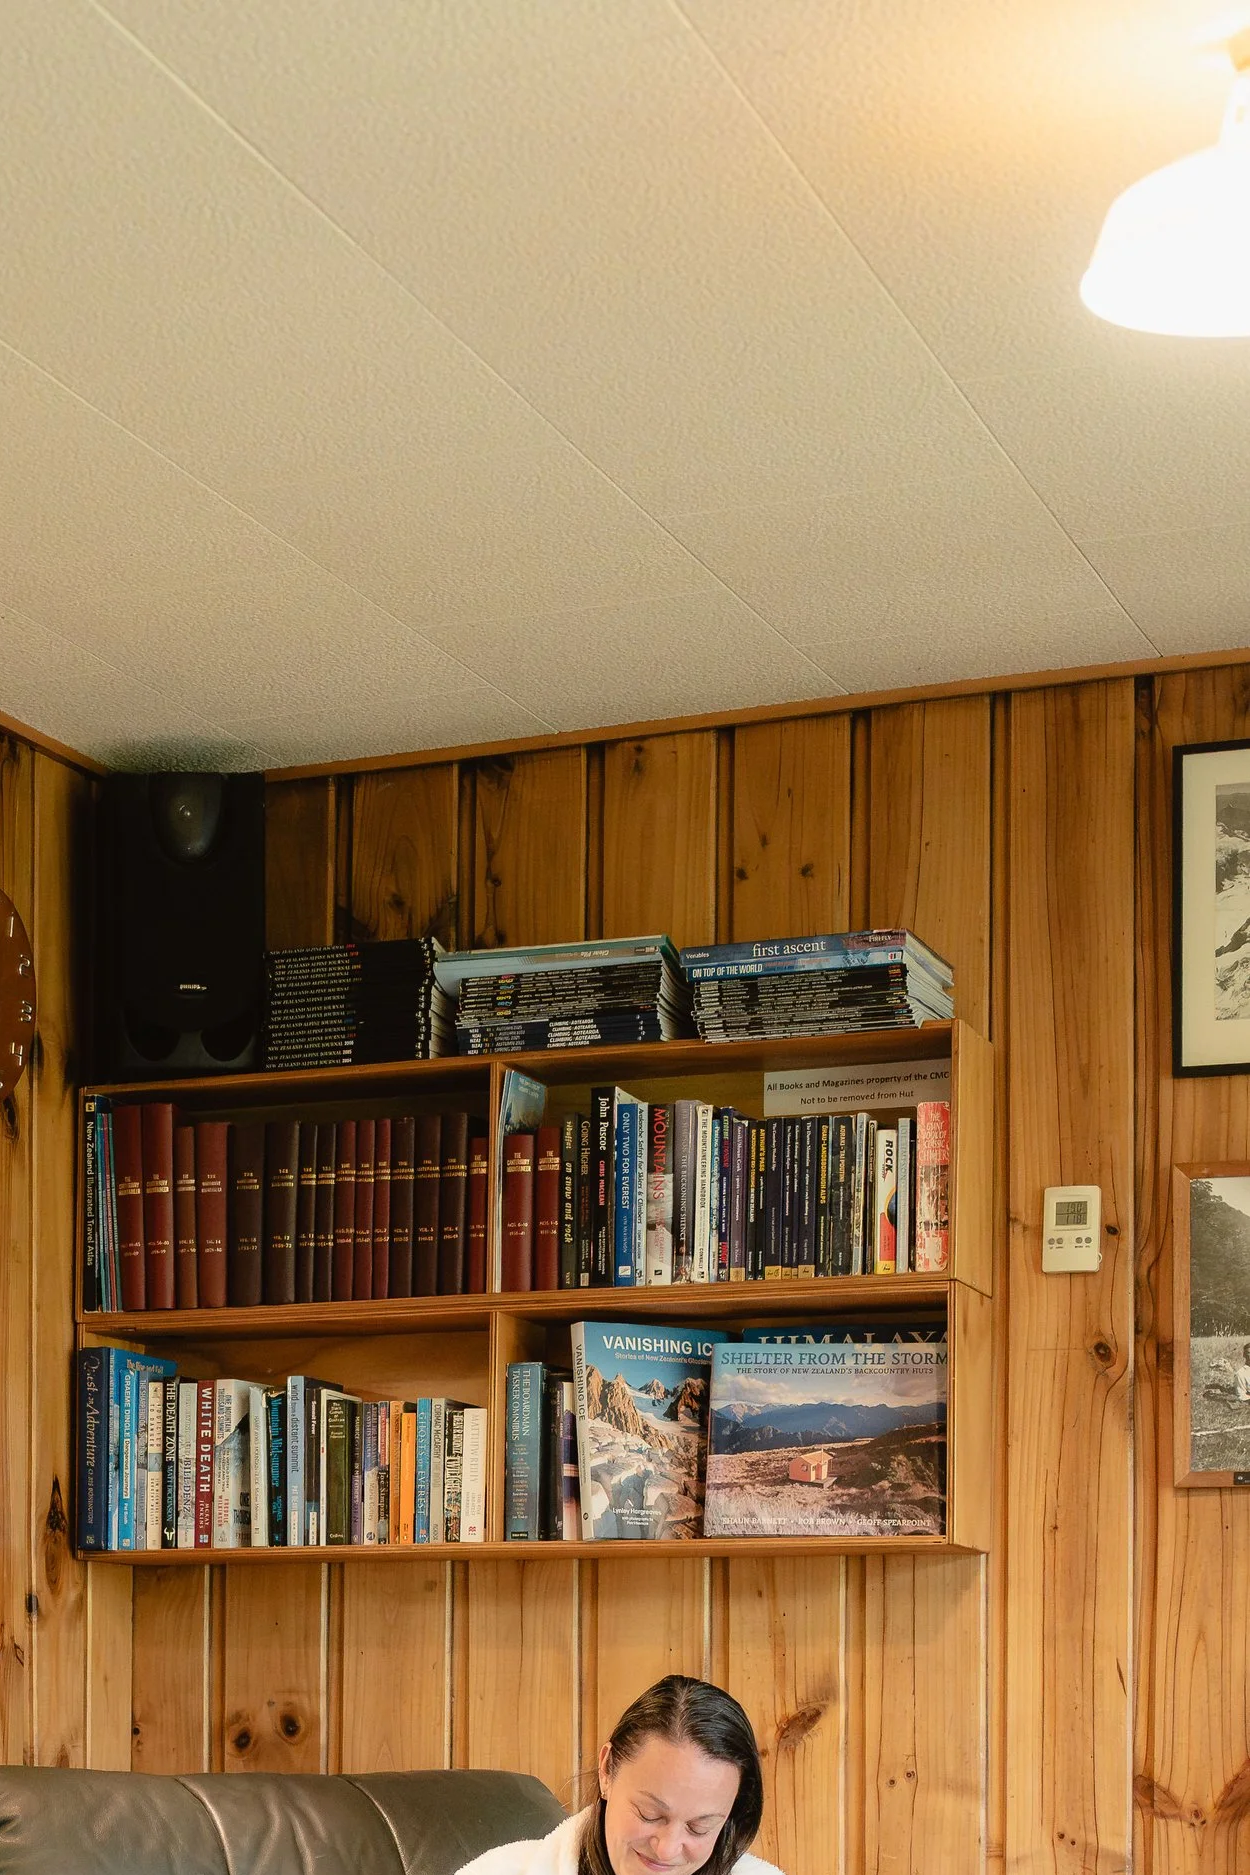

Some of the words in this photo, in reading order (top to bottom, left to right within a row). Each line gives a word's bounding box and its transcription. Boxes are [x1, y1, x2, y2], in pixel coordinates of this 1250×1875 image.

[9, 911, 15, 938] 1
[686, 951, 710, 960] Venables
[752, 942, 780, 957] first
[783, 940, 826, 954] ascent
[18, 954, 30, 977] 2
[692, 968, 702, 978] ON
[703, 967, 716, 977] TOP
[716, 966, 726, 976] OF
[726, 966, 738, 975] THE
[738, 964, 762, 974] WORLD
[20, 1000, 32, 1022] 3
[11, 1042, 23, 1067] 4
[766, 1084, 778, 1092] All
[780, 1082, 804, 1090] Books
[822, 1078, 864, 1088] Magazines
[866, 1075, 902, 1086] property
[903, 1074, 913, 1082] of
[914, 1072, 928, 1080] the
[929, 1071, 950, 1080] CMC
[598, 1096, 610, 1118] John
[800, 1096, 815, 1105] Not
[816, 1096, 826, 1104] to
[828, 1094, 838, 1103] be
[839, 1092, 875, 1102] removed
[877, 1092, 897, 1100] from
[899, 1090, 914, 1098] Hut
[86, 1121, 95, 1141] New
[580, 1120, 590, 1146] GOING
[622, 1112, 630, 1134] ONLY
[700, 1118, 708, 1129] THE
[599, 1121, 610, 1150] Pascoe
[622, 1136, 630, 1156] TWO
[758, 1128, 766, 1155] ARTHUR'S
[86, 1142, 95, 1175] Zealand
[636, 1140, 644, 1158] Safety
[653, 1108, 666, 1200] MOUNTAINS
[700, 1130, 708, 1178] MOUNTAINEERING
[565, 1162, 572, 1173] on
[580, 1147, 590, 1176] HIGHER
[622, 1158, 630, 1174] FOR
[636, 1160, 644, 1169] for
[758, 1156, 766, 1172] PASS
[86, 1176, 95, 1217] Illustrated
[622, 1176, 630, 1210] EVEREST
[565, 1202, 574, 1220] and
[86, 1219, 95, 1244] Travel
[564, 1223, 574, 1243] rock
[86, 1246, 95, 1266] Atlas
[602, 1335, 693, 1355] VANISHING
[697, 1342, 713, 1357] IC
[614, 1352, 637, 1360] Stories
[659, 1356, 688, 1364] Zealand's
[721, 1352, 794, 1366] SHELTER
[798, 1352, 846, 1366] FROM
[852, 1352, 886, 1366] THE
[892, 1352, 948, 1366] STORM
[522, 1368, 530, 1386] THE
[575, 1344, 584, 1402] VANISHING
[810, 1367, 853, 1375] ZEALAND'S
[854, 1368, 911, 1376] BACKCOUNTRY
[912, 1367, 934, 1376] HUTS
[166, 1382, 175, 1401] THE
[291, 1384, 300, 1401] wind
[512, 1368, 520, 1400] TASKER
[224, 1394, 232, 1406] ONE
[522, 1388, 530, 1436] BOARDMAN
[166, 1402, 175, 1434] DEATH
[201, 1387, 212, 1438] WHITE
[224, 1406, 232, 1433] MOUNTAIN
[271, 1398, 282, 1436] Mountain
[434, 1404, 442, 1428] CORMAC
[512, 1402, 520, 1441] OMNIBUS
[578, 1404, 586, 1422] ICE
[85, 1403, 100, 1467] Adventure
[291, 1418, 300, 1444] distant
[418, 1412, 427, 1456] GHOSTS
[166, 1436, 174, 1462] ZONE
[433, 1429, 442, 1459] McCARTHY
[200, 1444, 211, 1492] DEATH
[271, 1438, 282, 1487] Midsummer
[291, 1444, 300, 1473] summit
[184, 1460, 192, 1482] BILL
[378, 1472, 386, 1484] Joe
[183, 1484, 191, 1514] DENZ
[378, 1487, 386, 1522] Simpson
[417, 1470, 426, 1516] EVEREST
[722, 1517, 750, 1525] SHAUN
[798, 1517, 815, 1525] ROB
[816, 1518, 846, 1526] BROWN
[856, 1518, 881, 1526] GEOFF
[883, 1519, 931, 1527] SPEARPOINT
